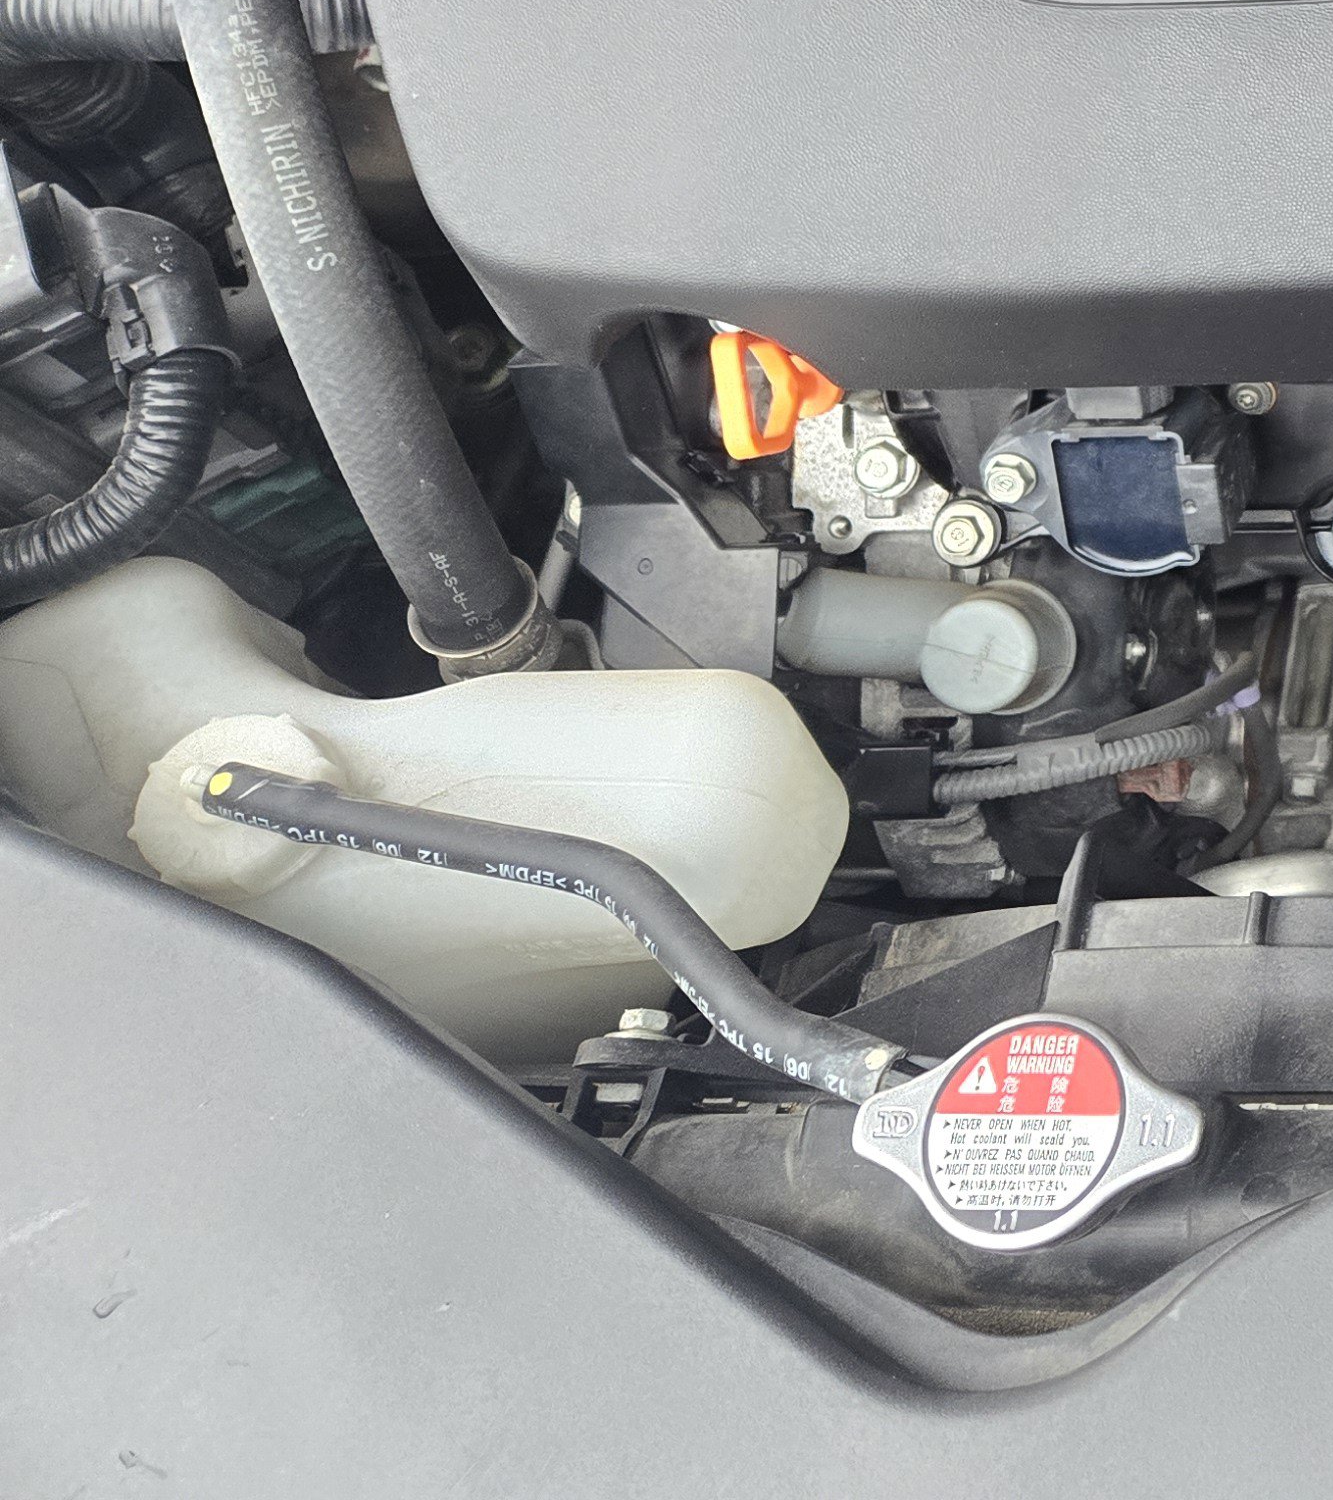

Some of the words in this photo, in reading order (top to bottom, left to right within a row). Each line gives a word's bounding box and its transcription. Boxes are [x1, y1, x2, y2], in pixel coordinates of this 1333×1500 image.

[287, 826, 331, 844] TPC
[336, 833, 360, 849] 15
[485, 862, 567, 889] >EPDM<
[718, 1019, 748, 1052] TPC
[1008, 1034, 1080, 1055] DANGER
[752, 1042, 775, 1064] 15
[1006, 1055, 1076, 1075] WARNUNG
[953, 1118, 982, 1130] NEVER
[988, 1119, 1013, 1130] OPEN
[1020, 1119, 1046, 1131] WHEN
[1052, 1119, 1072, 1131] HOT.
[1139, 1112, 1176, 1148] 1.1
[950, 1133, 966, 1144] Hot
[973, 1133, 1008, 1144] coolant
[1014, 1133, 1032, 1145] will
[1039, 1134, 1065, 1146] scald
[1071, 1137, 1091, 1148] you.
[965, 1149, 1000, 1161] OUVREZ
[1004, 1149, 1022, 1161] PAS
[1027, 1150, 1059, 1161] QUAND
[1064, 1150, 1095, 1162] CHAUD.
[944, 1163, 969, 1175] NICHT
[972, 1164, 986, 1175] BEI
[989, 1164, 1025, 1175] HEISSEM
[1027, 1164, 1056, 1175] MOTOR
[993, 1209, 1019, 1232] 1.1
